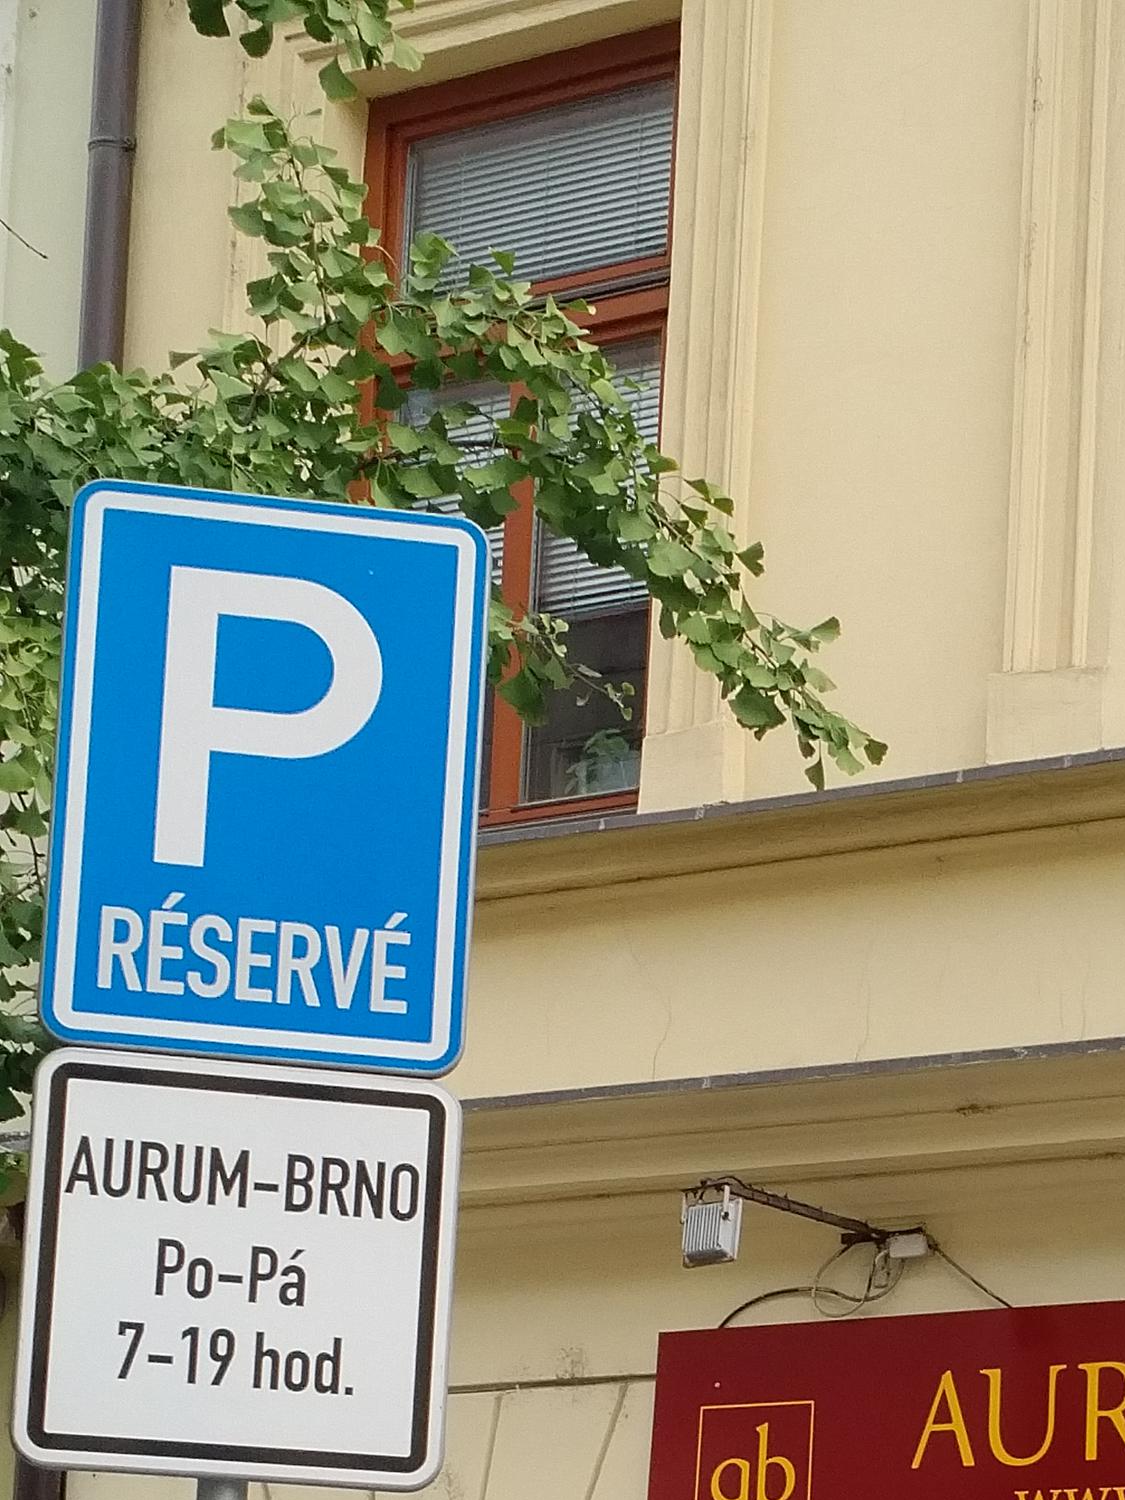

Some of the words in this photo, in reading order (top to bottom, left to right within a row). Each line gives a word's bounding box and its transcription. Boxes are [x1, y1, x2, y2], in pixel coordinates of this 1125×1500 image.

[154, 566, 382, 866] P
[98, 893, 410, 1013] RÉSERVÉ
[65, 1136, 419, 1221] AURUM-BRNO
[155, 1239, 305, 1306] Po-Pá
[118, 1321, 234, 1385] 7-19
[253, 1332, 353, 1395] hod.
